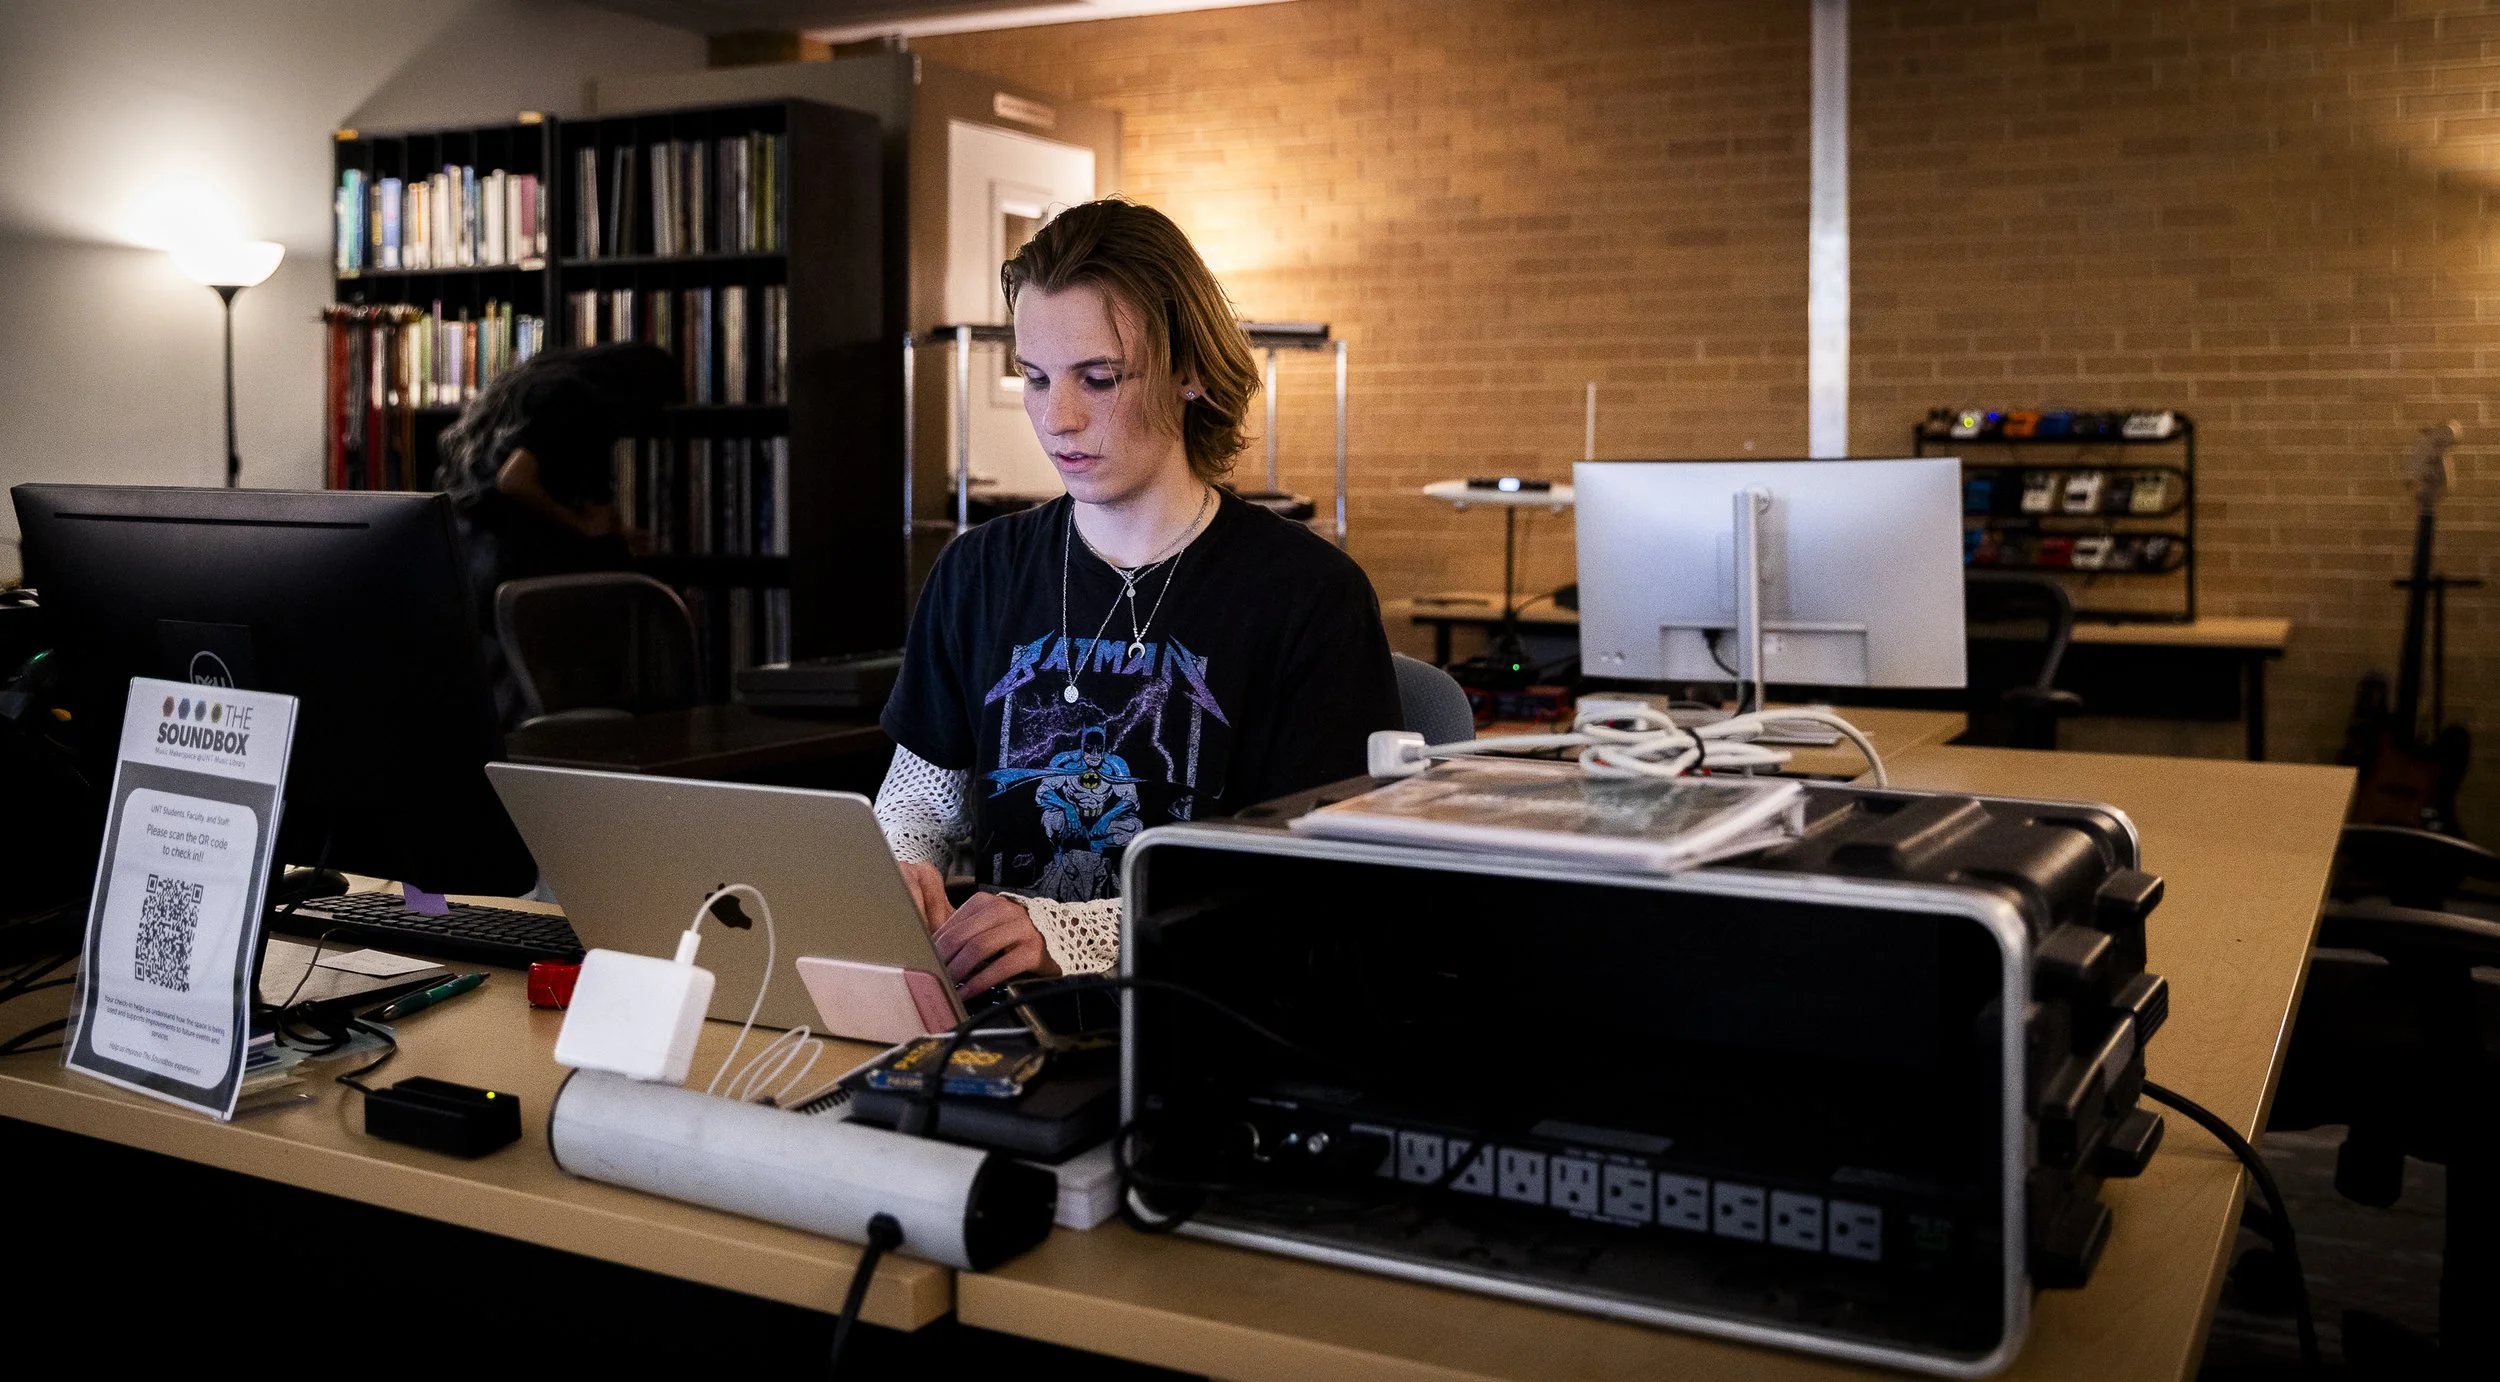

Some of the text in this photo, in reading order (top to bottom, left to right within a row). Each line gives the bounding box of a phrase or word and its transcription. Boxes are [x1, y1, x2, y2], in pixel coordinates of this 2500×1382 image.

[985, 629, 1231, 727] BATMAN
[226, 704, 253, 730] THE
[157, 721, 249, 756] SOUNDBOX
[151, 804, 162, 813] UNT
[206, 815, 217, 824] and
[147, 823, 228, 850] Please scan the QR code
[163, 845, 170, 855] to
[171, 847, 191, 860] check
[152, 1008, 175, 1020] understand
